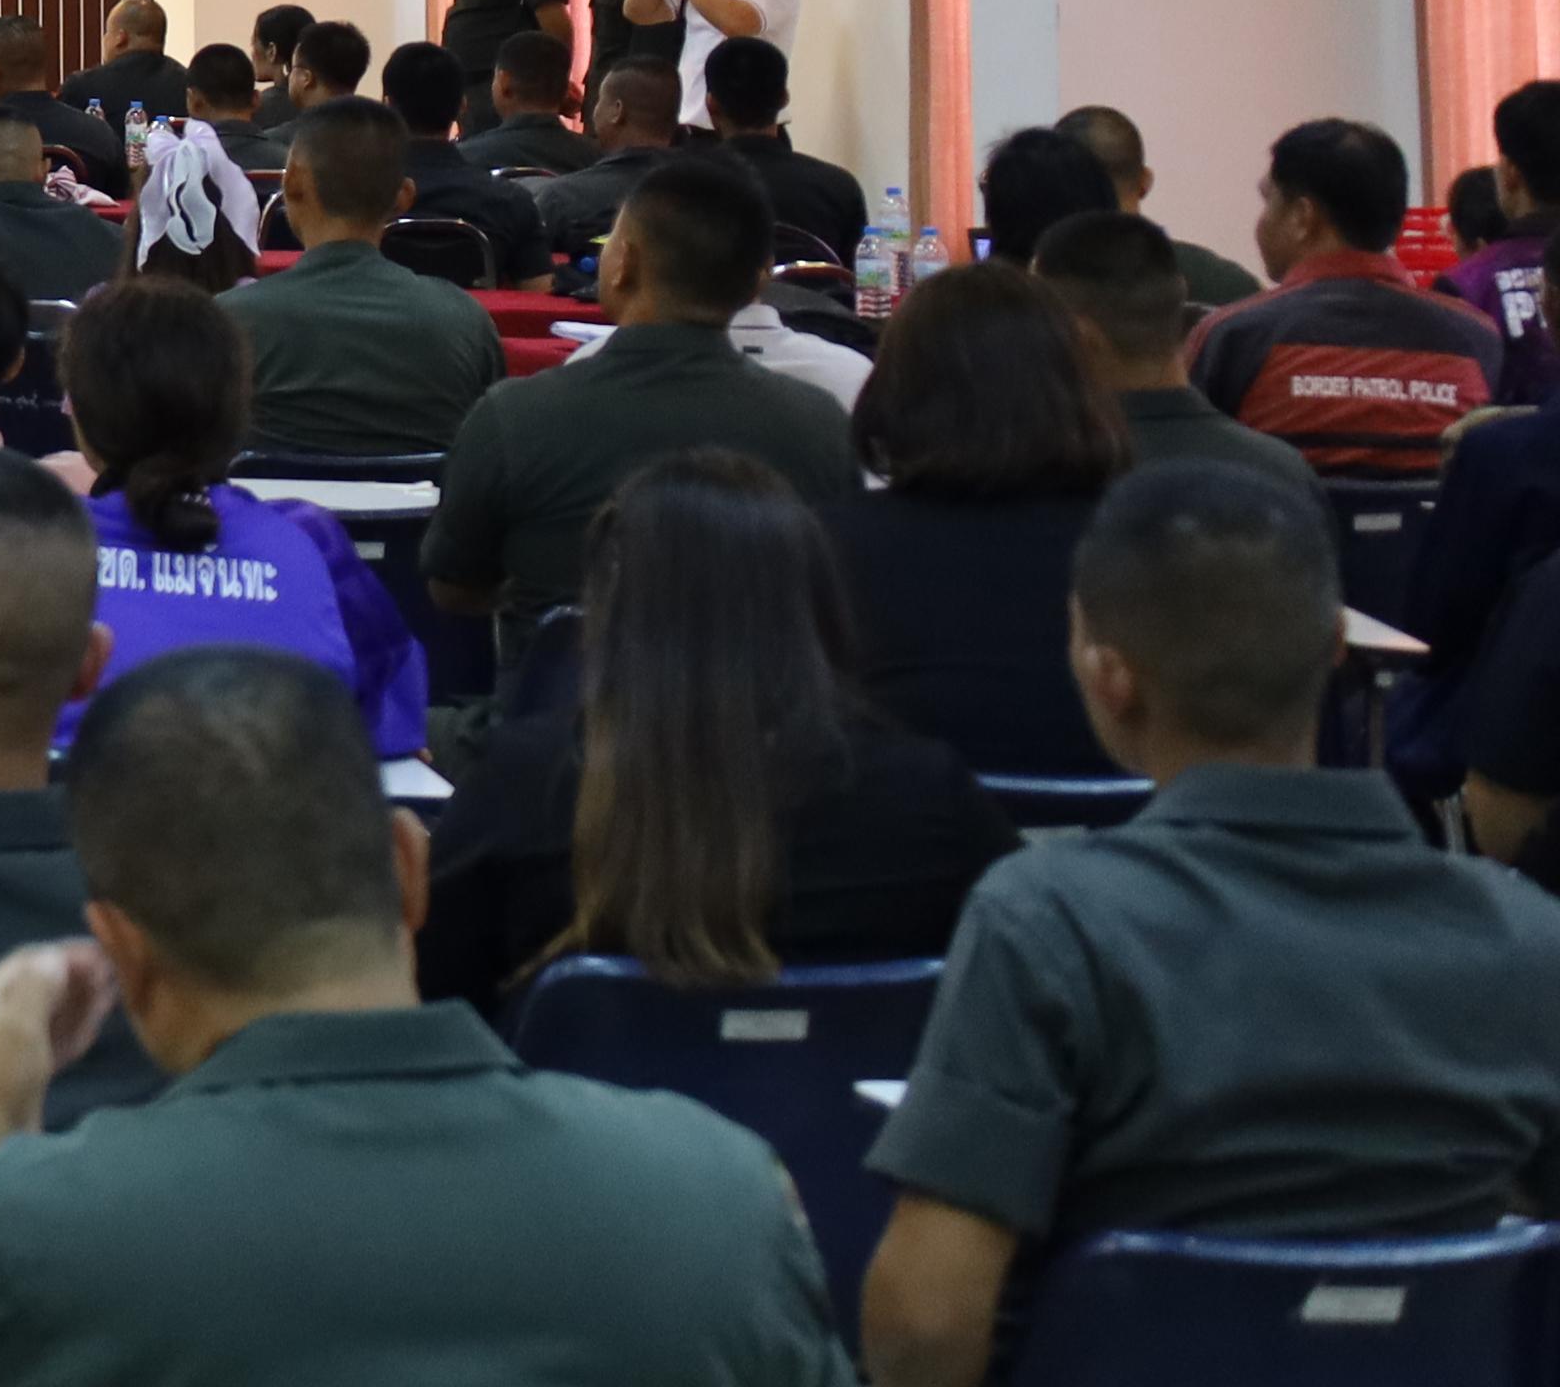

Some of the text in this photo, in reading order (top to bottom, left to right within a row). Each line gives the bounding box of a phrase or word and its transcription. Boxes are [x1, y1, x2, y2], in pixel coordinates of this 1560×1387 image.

[1291, 375, 1458, 407] BORDER PATROL POLICE
